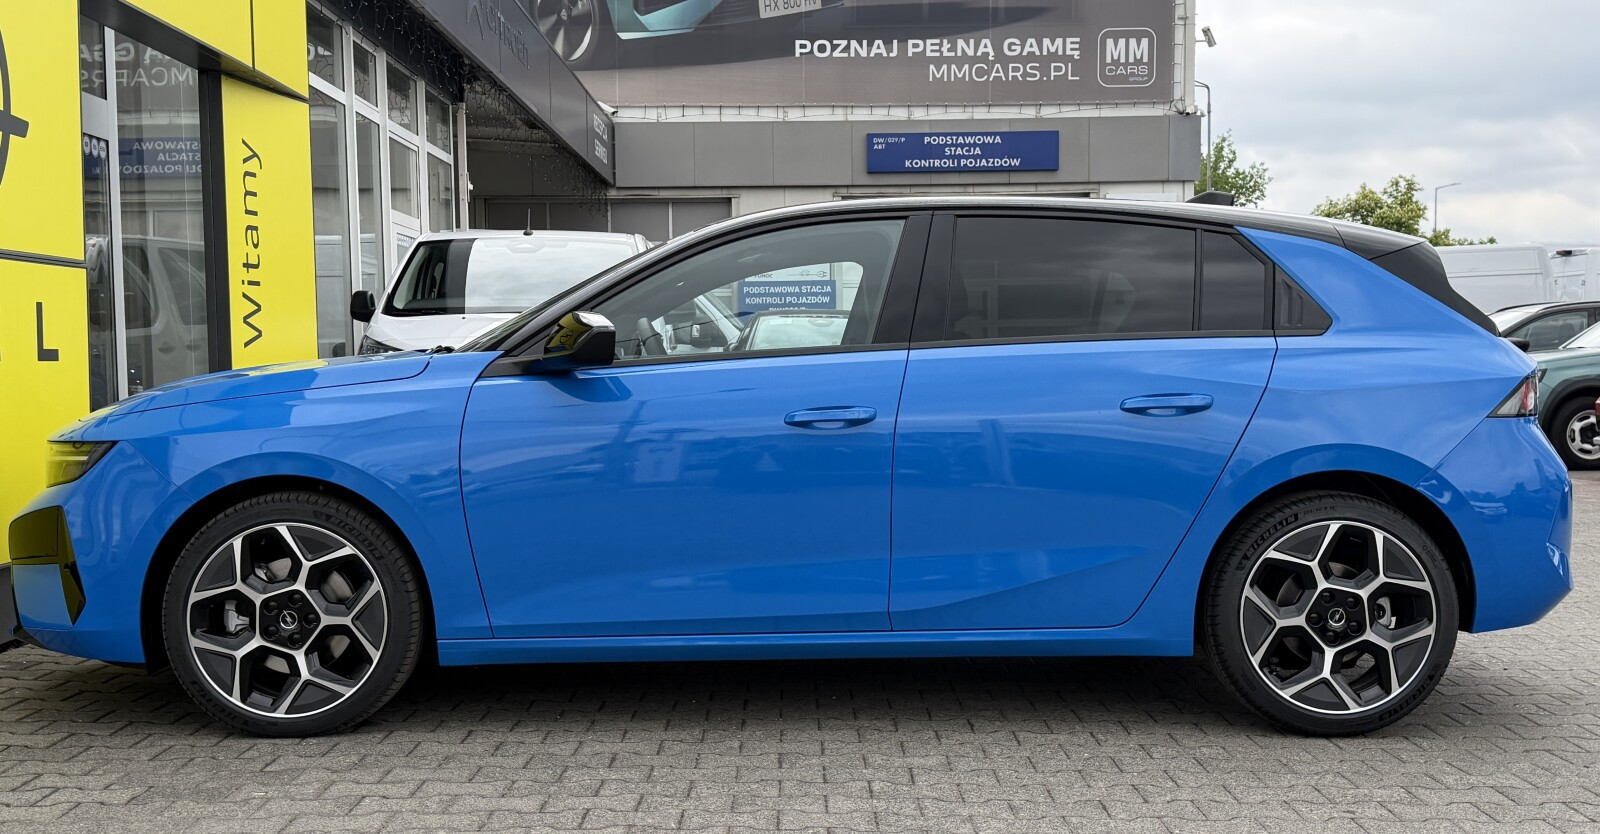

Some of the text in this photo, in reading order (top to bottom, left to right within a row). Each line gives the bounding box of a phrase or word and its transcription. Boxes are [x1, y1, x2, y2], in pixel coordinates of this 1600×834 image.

[794, 37, 1081, 61] POZNAJ PEŁNĄ GAMĘ
[1105, 37, 1149, 63] MM
[929, 63, 1080, 82] MMCARS.PL
[1105, 65, 1149, 76] CARS
[924, 135, 1002, 145] PODSTAWOWA
[944, 146, 982, 156] STACJA
[905, 155, 1021, 168] KONTROLI POJAZDÓW
[241, 137, 263, 349] Witamy
[743, 285, 832, 294] PODSTAWOWA STACJA
[745, 295, 830, 304] KONTROLI POJAZDÓW
[1245, 513, 1298, 559] MICHELIN
